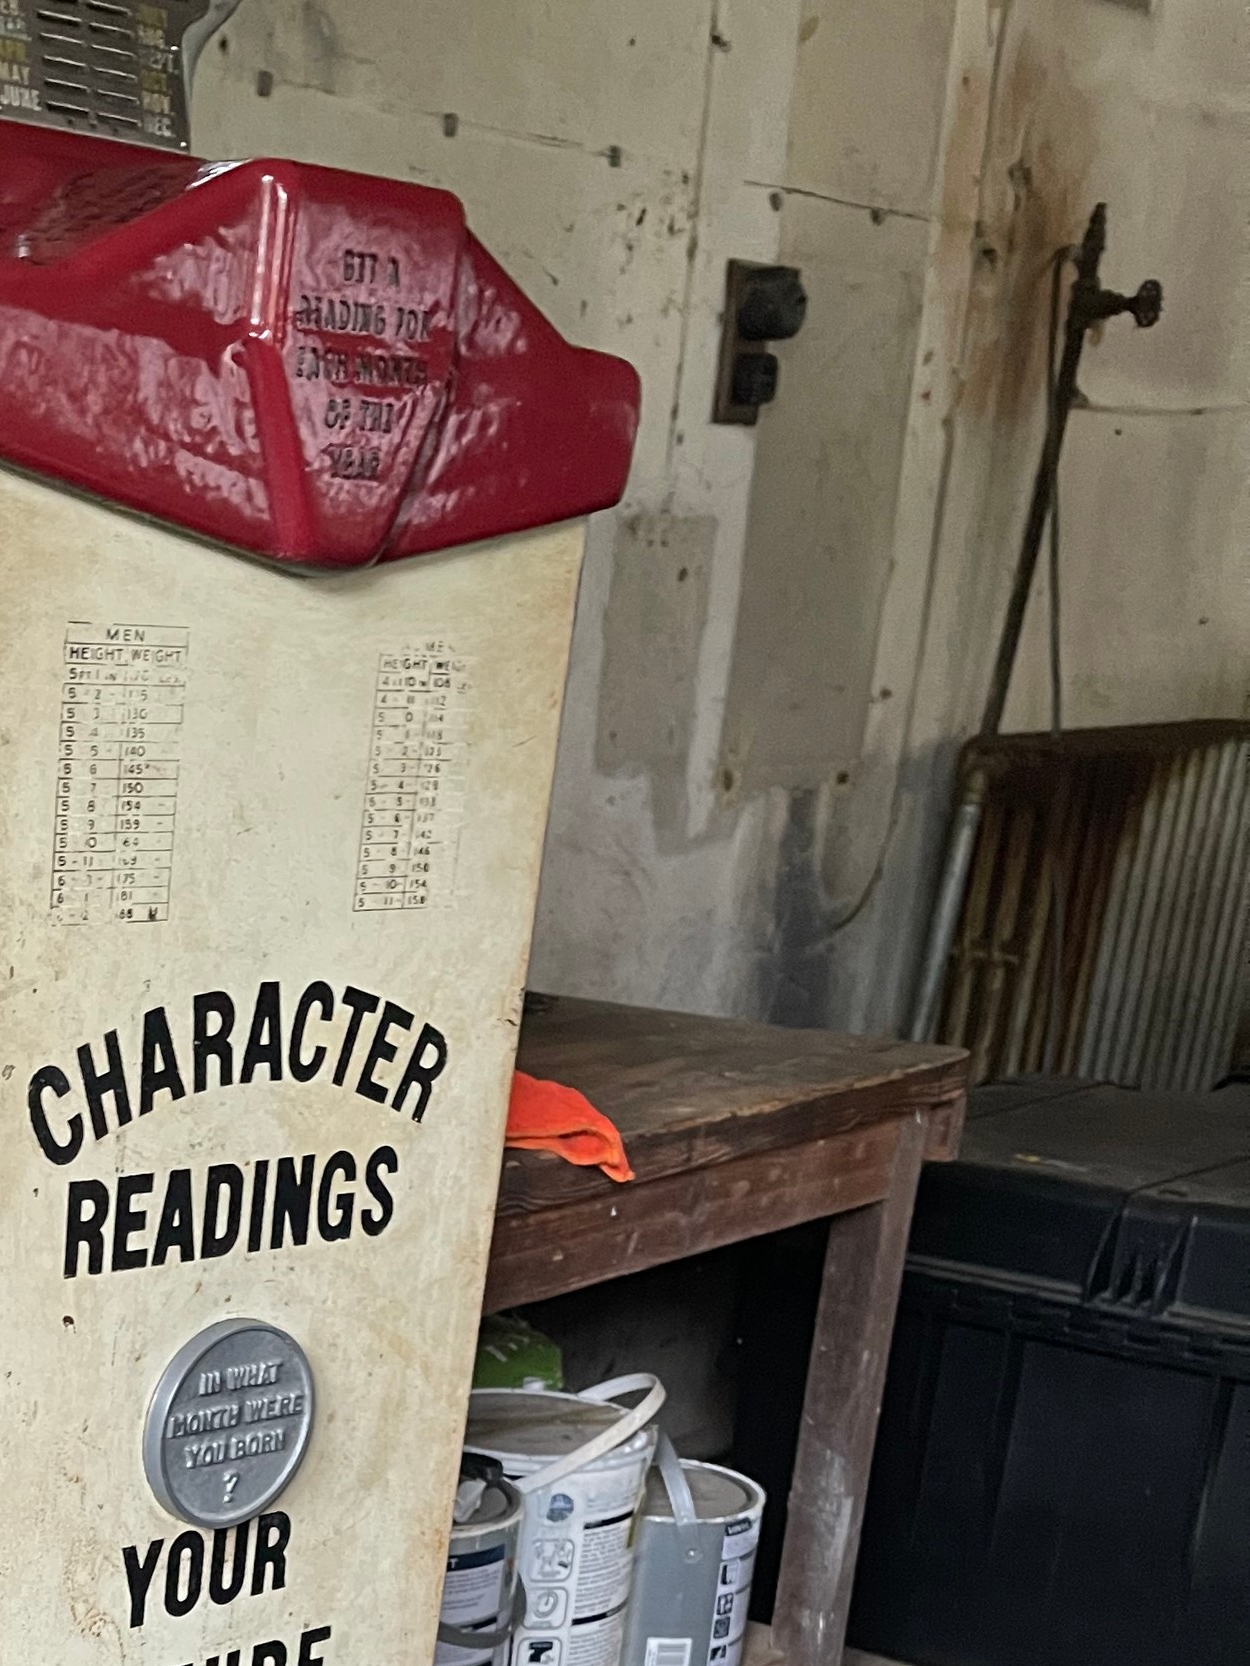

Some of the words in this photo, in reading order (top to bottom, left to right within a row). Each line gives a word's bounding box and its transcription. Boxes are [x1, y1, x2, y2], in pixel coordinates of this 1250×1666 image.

[0, 84, 41, 111] JUNE
[295, 295, 386, 335] READING
[69, 647, 123, 660] HEIGHT
[131, 650, 181, 663] WEIGHT
[106, 629, 145, 642] MEN
[29, 981, 448, 1165] CHARACTER
[63, 1146, 398, 1280] READINGS
[198, 1371, 221, 1396] IN
[226, 1359, 282, 1390] WHAT
[166, 1404, 240, 1439] MONTH
[244, 1392, 304, 1424] WERE
[184, 1440, 229, 1469] YOU
[230, 1429, 286, 1460] BORN
[223, 1472, 240, 1504] ?
[122, 1511, 291, 1628] YOUR
